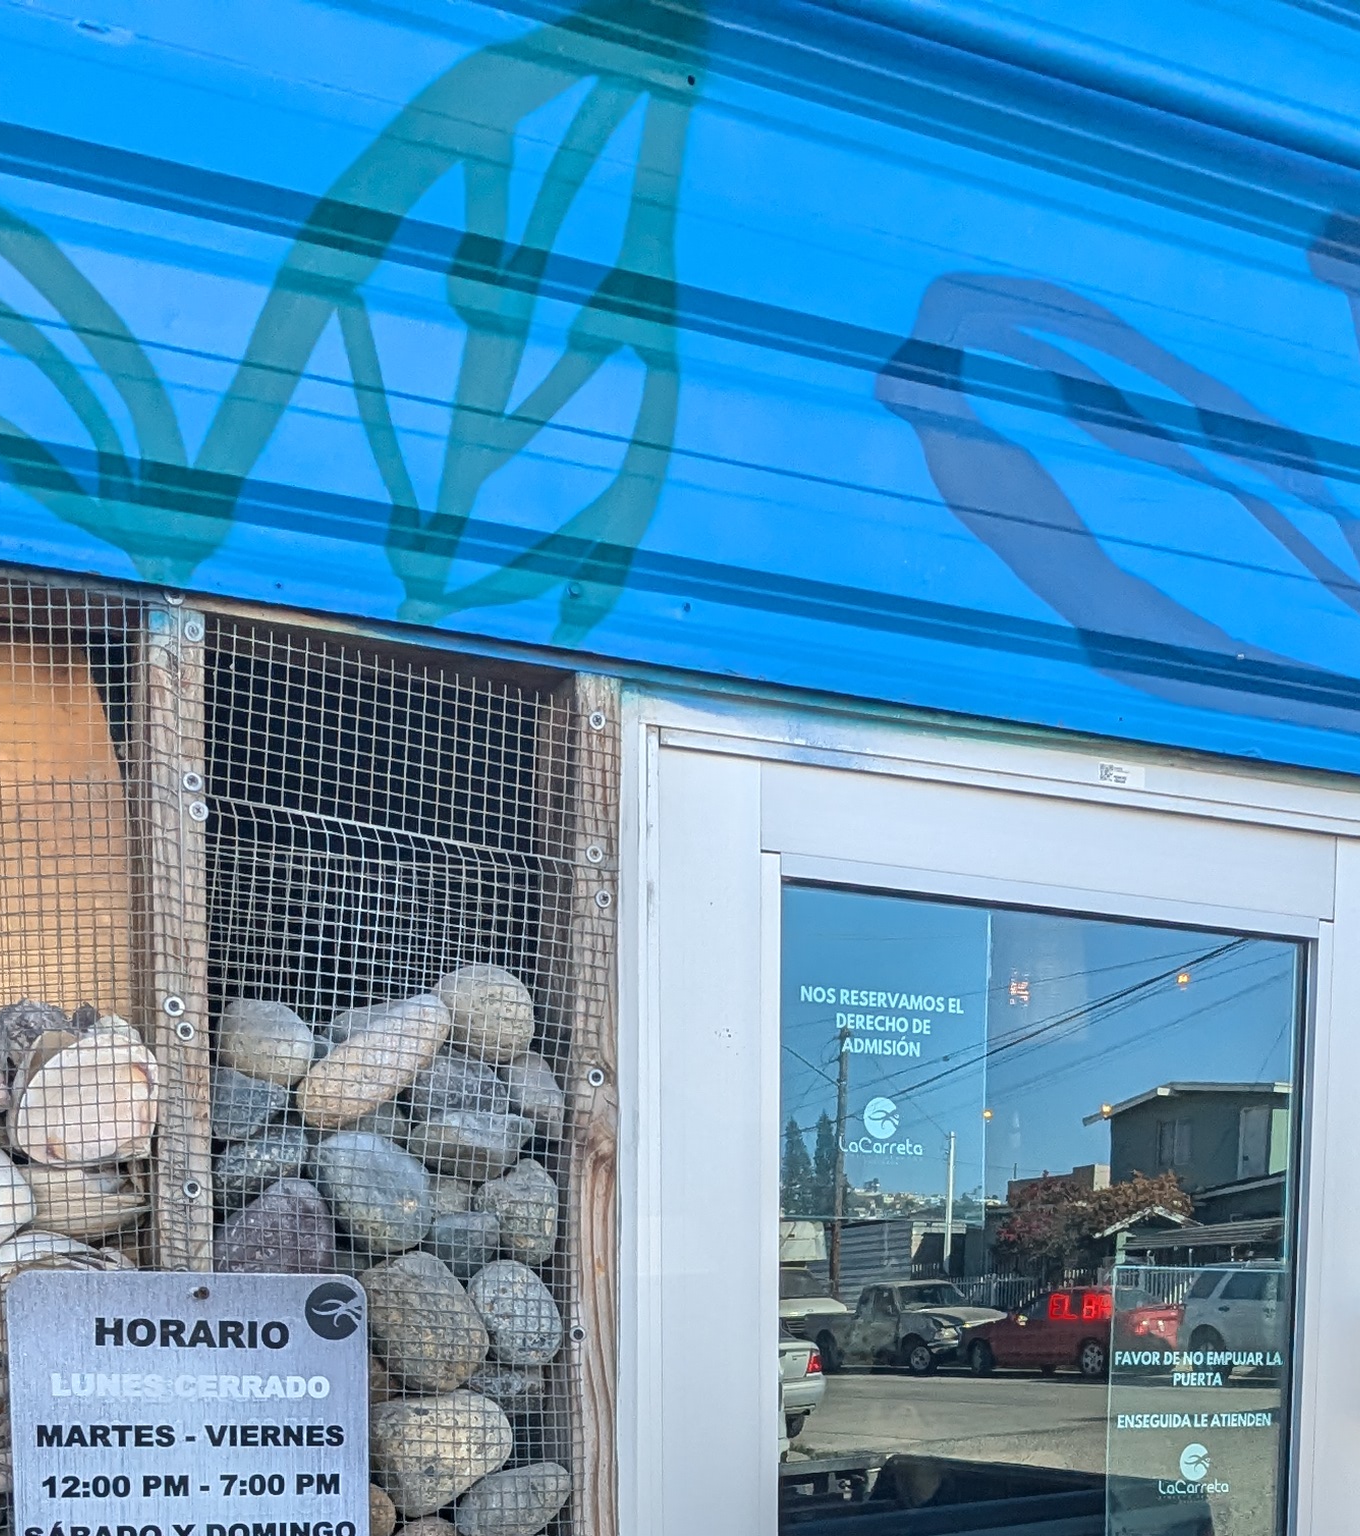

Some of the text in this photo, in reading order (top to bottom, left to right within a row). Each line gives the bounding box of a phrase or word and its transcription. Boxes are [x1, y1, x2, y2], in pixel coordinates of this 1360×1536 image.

[800, 985, 965, 1014] NOS RESERVAMOS EL
[836, 1012, 931, 1035] DERECHO DE
[842, 1036, 921, 1058] ADMISIÓN
[94, 1317, 290, 1349] HORARIO
[1114, 1351, 1284, 1366] FAVOR DE NO EMPUJAR LA
[50, 1373, 330, 1400] LUNES CERRADO
[1172, 1372, 1223, 1387] PUERTA
[1116, 1412, 1272, 1429] ENSEGUIDA LE ATIENDEN
[36, 1424, 176, 1448] MARTES
[205, 1424, 345, 1448] VIERNES
[42, 1475, 131, 1499] 12:00
[143, 1475, 190, 1497] PM
[220, 1474, 285, 1496] 7:00
[296, 1473, 341, 1495] PM
